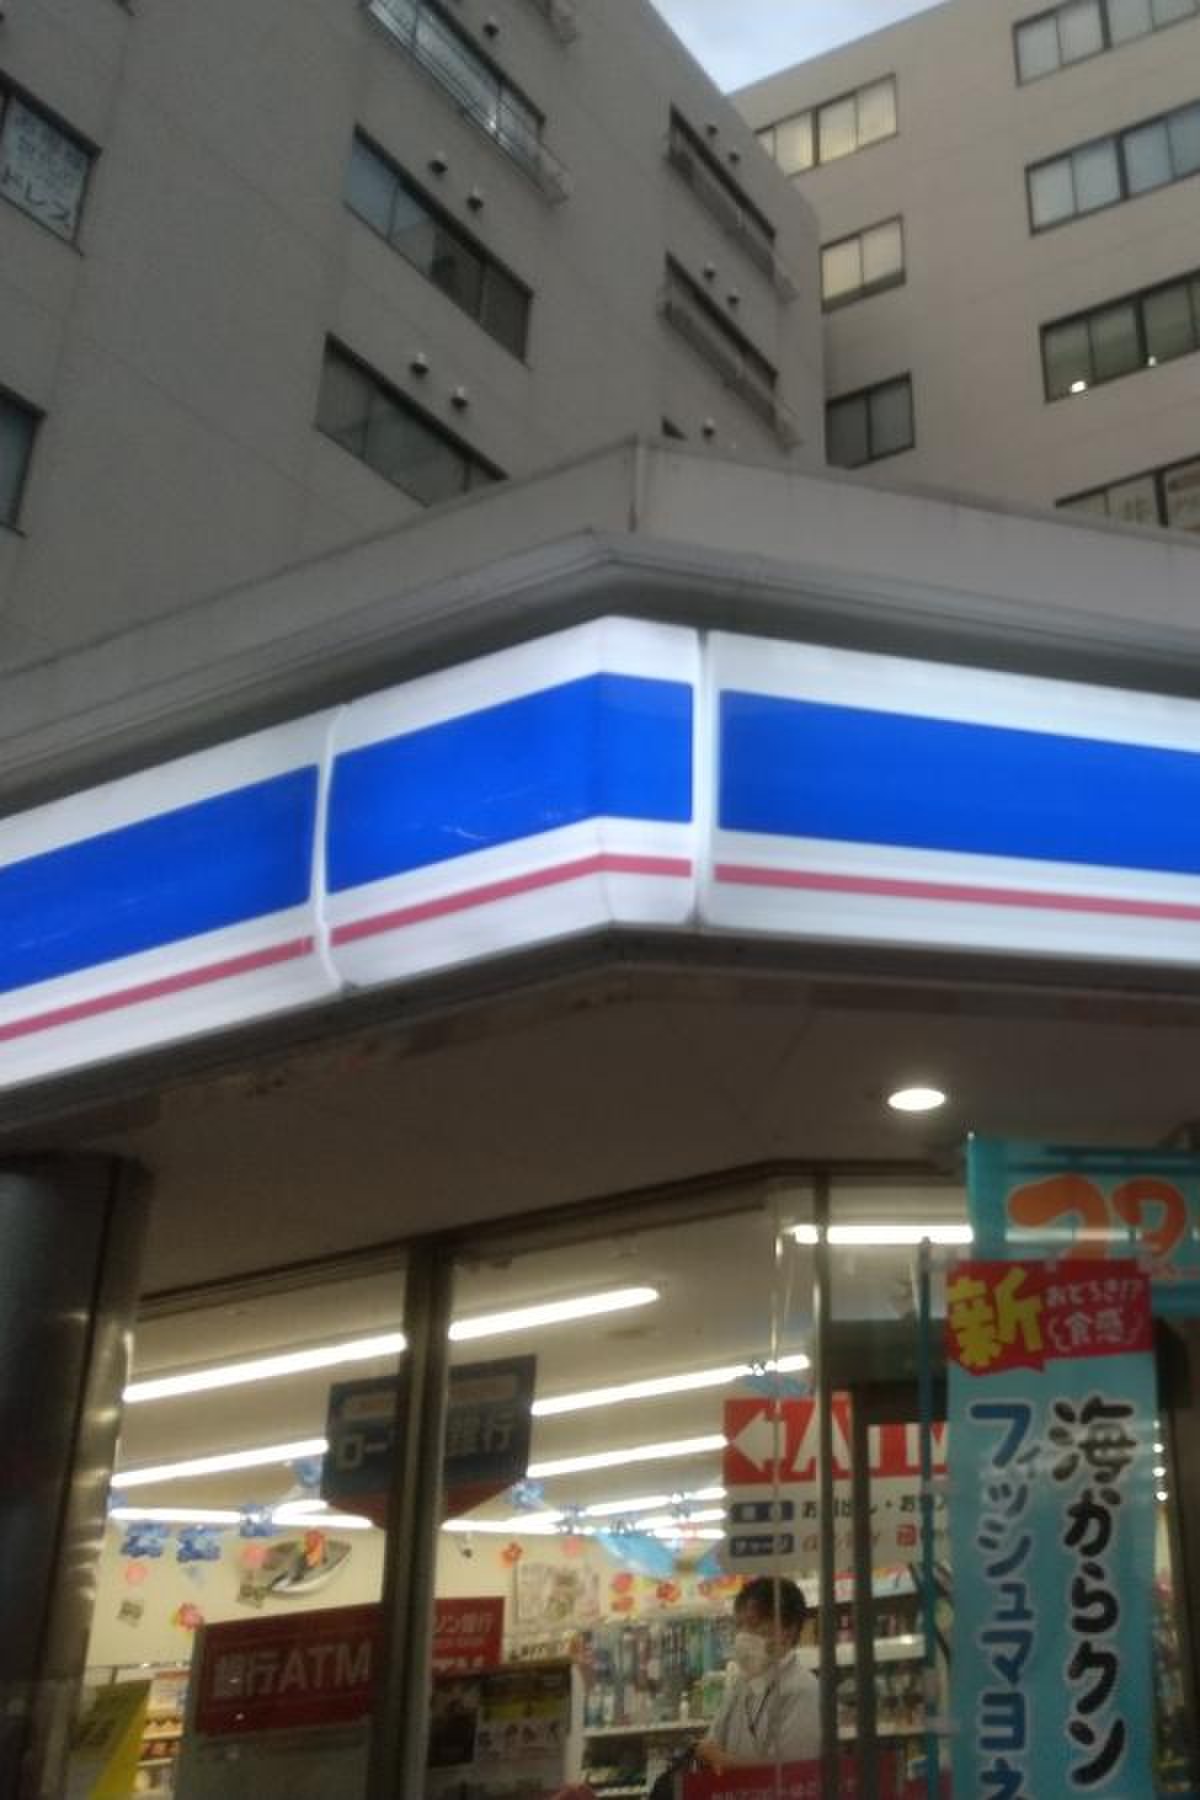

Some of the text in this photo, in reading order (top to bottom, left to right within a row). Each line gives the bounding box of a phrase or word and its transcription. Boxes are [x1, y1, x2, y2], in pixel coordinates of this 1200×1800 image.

[945, 1264, 1044, 1368] 新
[1048, 1394, 1139, 1788] 海からケン
